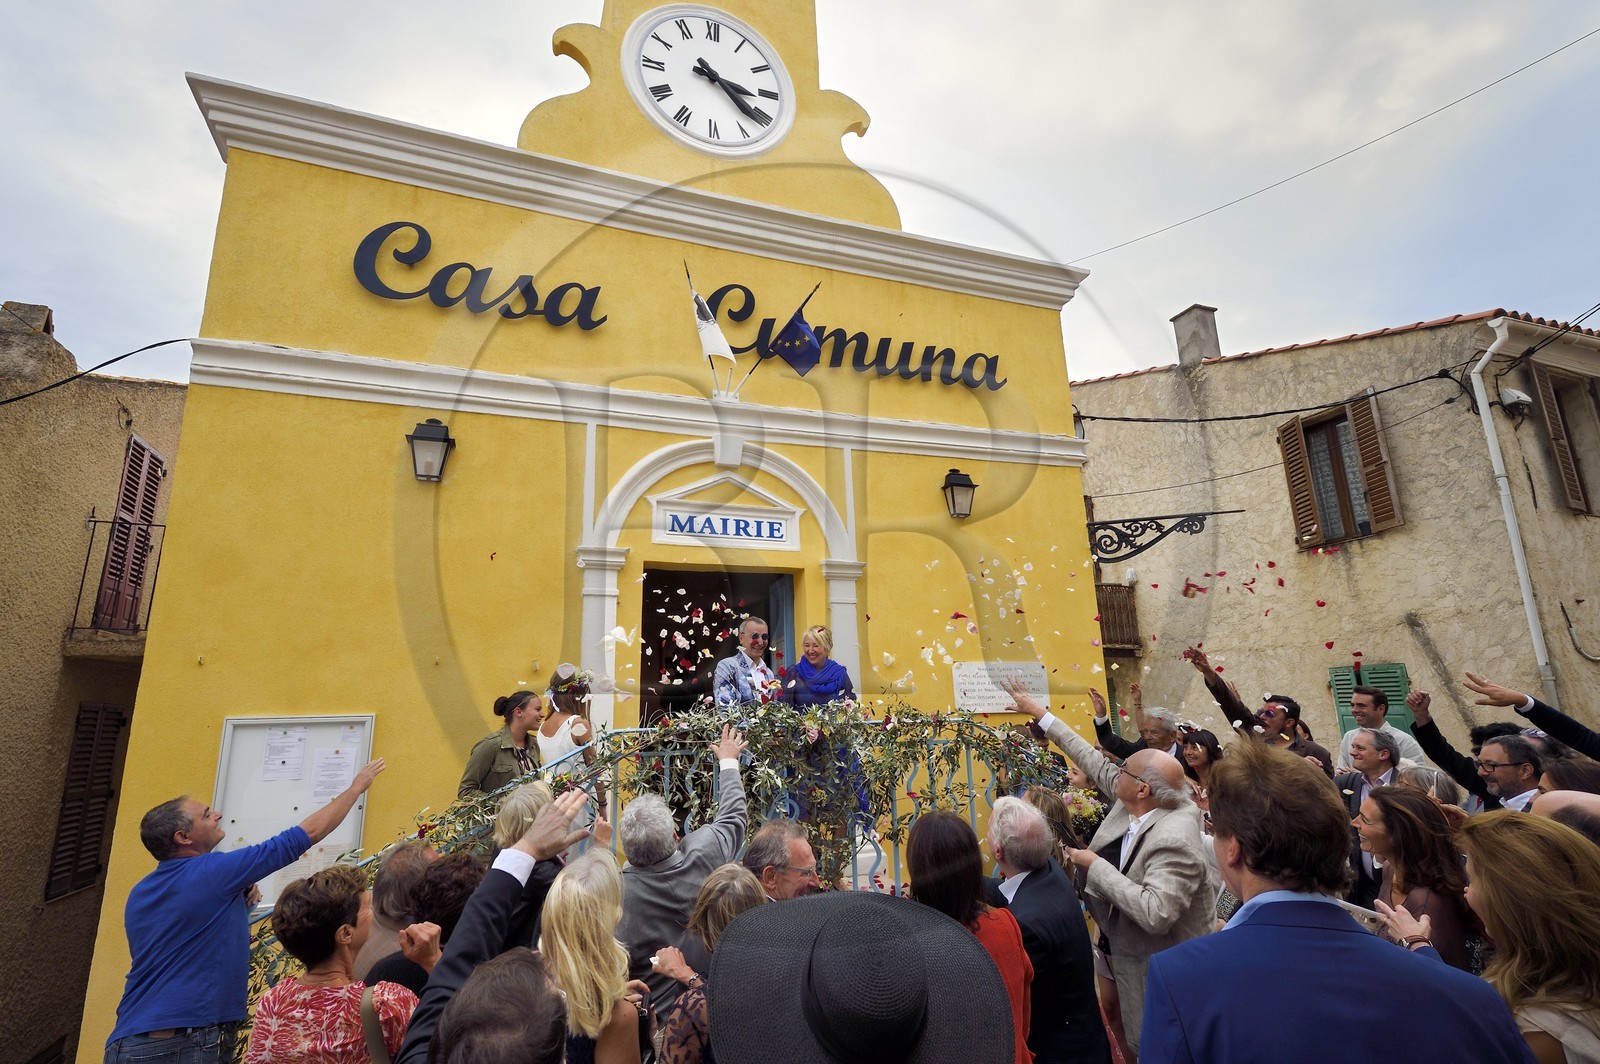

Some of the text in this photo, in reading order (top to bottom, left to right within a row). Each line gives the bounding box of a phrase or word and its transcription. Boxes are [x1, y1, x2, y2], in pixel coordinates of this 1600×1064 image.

[675, 19, 693, 40] XI
[705, 20, 719, 42] XII
[651, 32, 673, 51] X
[734, 39, 746, 53] I
[642, 55, 665, 71] IX
[750, 64, 770, 73] II
[648, 83, 674, 102] VIII
[673, 105, 692, 127] VII
[708, 118, 720, 140] VI
[736, 120, 750, 139] V
[353, 221, 608, 331] Casa
[668, 513, 784, 540] MAIRIE
